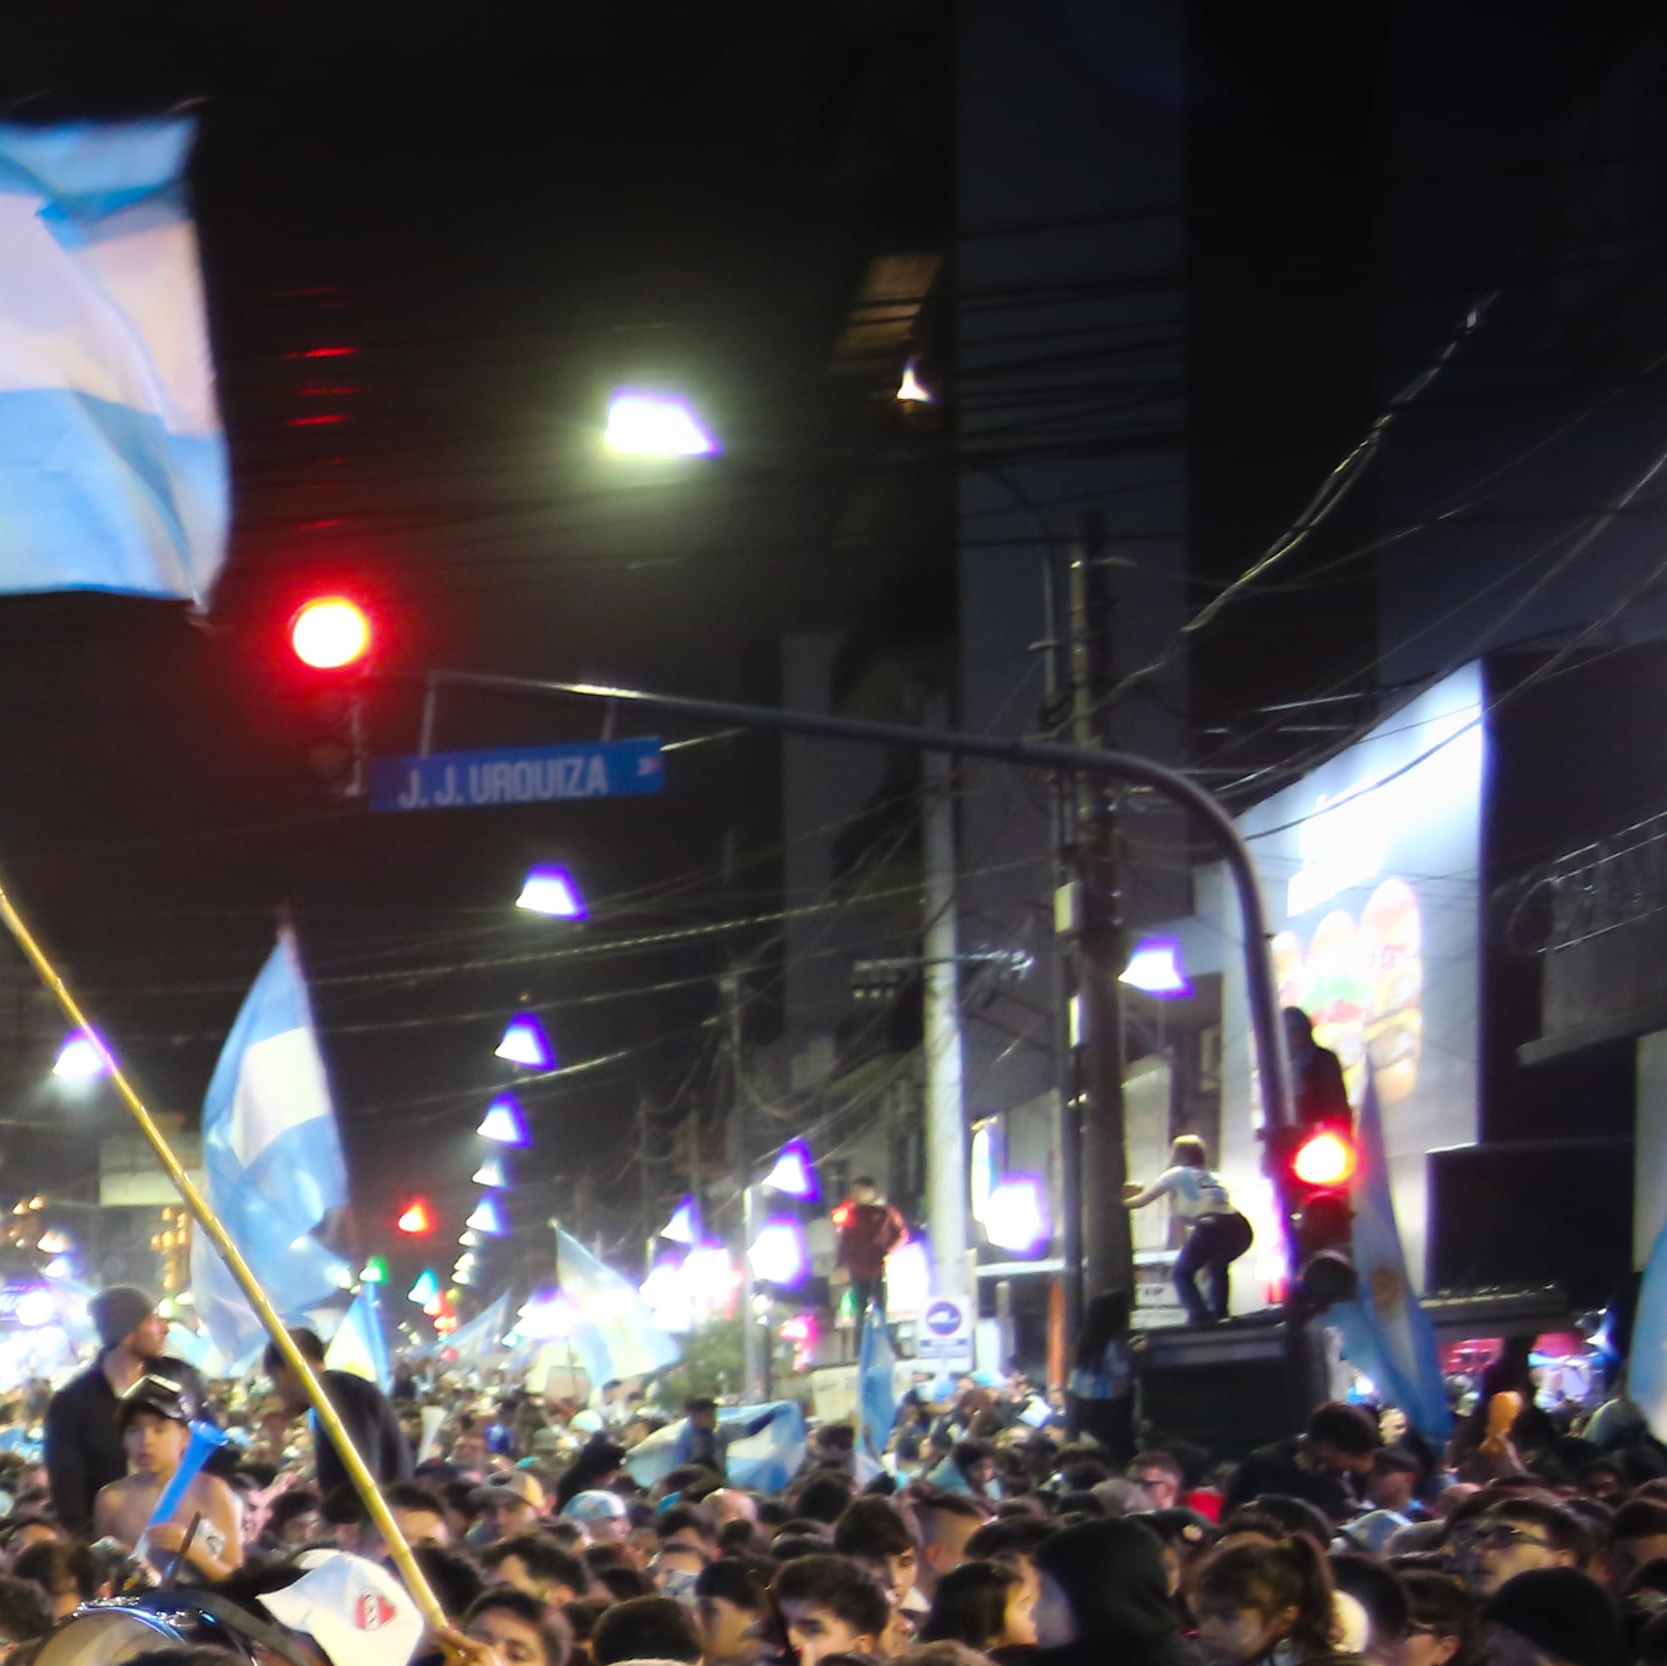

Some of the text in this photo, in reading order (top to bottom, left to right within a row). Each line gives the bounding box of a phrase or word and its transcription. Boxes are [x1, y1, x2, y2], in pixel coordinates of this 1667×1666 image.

[399, 755, 610, 809] J. J. URQUIZA
